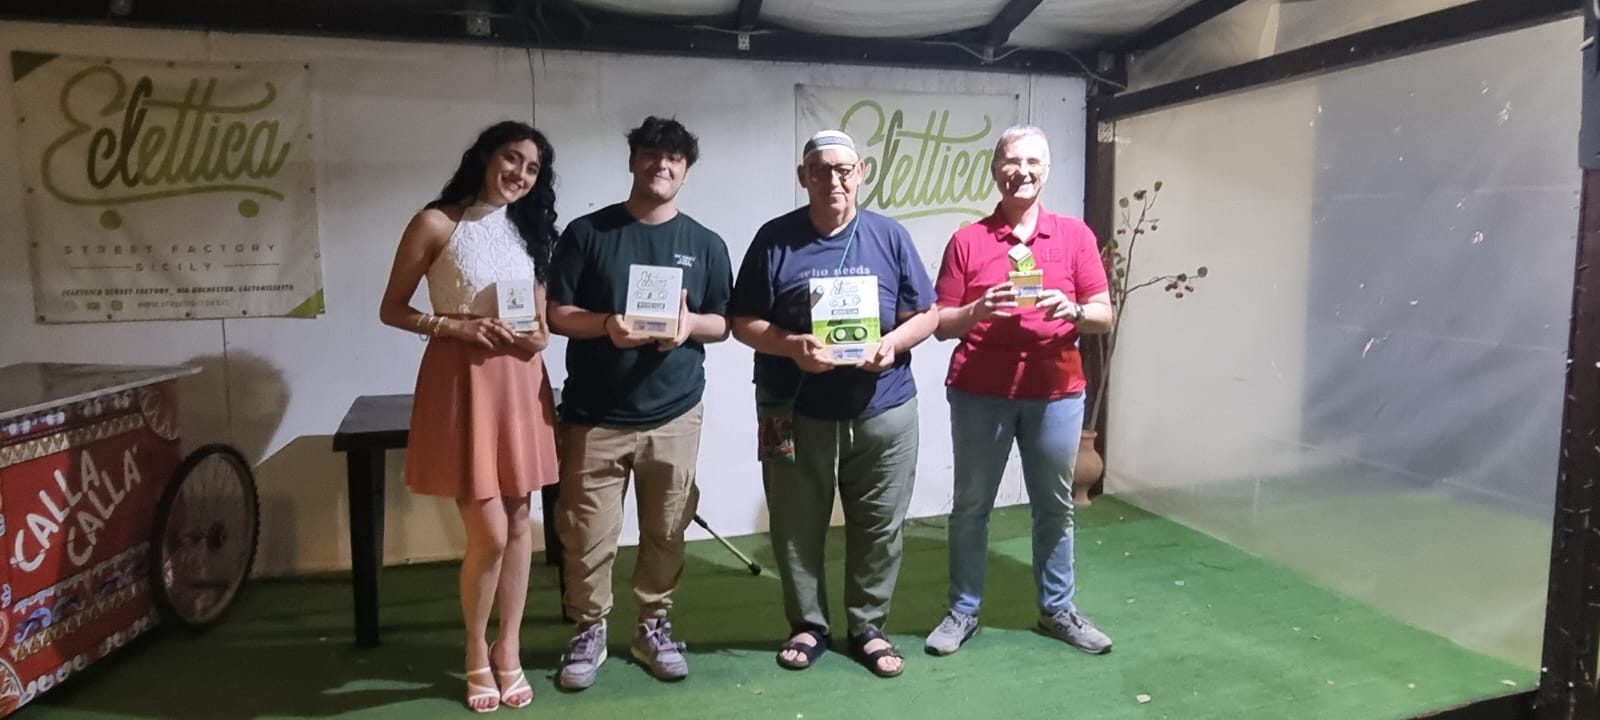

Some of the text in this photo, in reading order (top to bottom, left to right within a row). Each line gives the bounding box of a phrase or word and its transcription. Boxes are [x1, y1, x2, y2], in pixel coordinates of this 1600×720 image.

[41, 65, 291, 206] Eclettica
[64, 244, 275, 256] STREET FACTORY
[135, 262, 212, 272] SICILY
